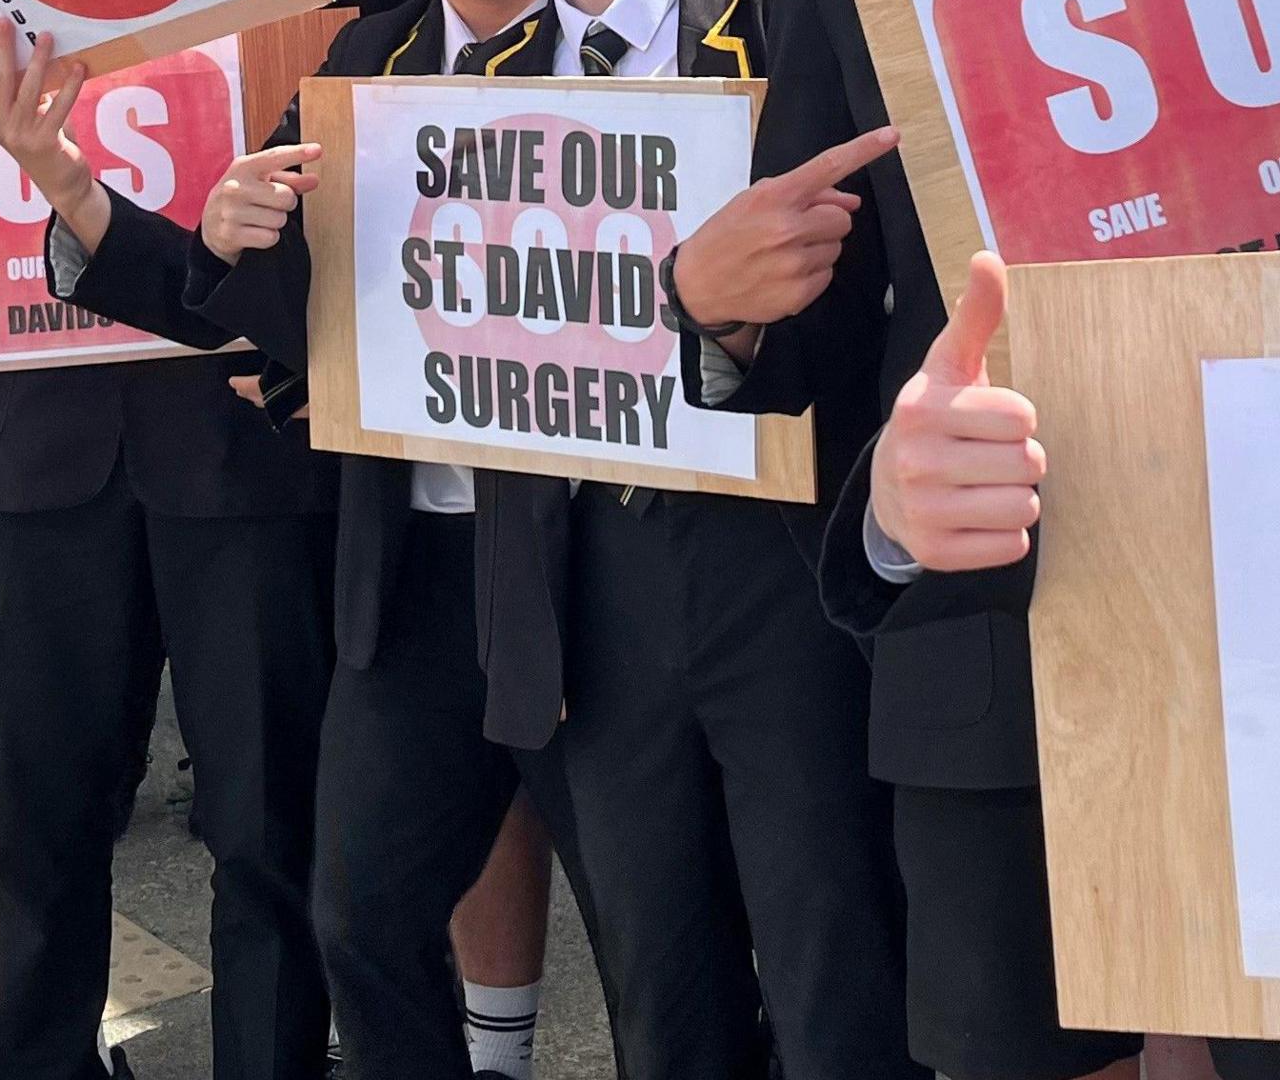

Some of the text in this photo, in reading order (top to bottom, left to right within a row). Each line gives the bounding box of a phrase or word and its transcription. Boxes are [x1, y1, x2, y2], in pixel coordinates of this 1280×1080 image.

[415, 124, 678, 212] SAVE OUR
[1087, 192, 1168, 244] SAVE
[6, 256, 46, 282] OUR
[401, 236, 683, 334] ST. DAVIDS
[7, 301, 115, 336] DAVIDS
[423, 350, 677, 450] SURGERY
